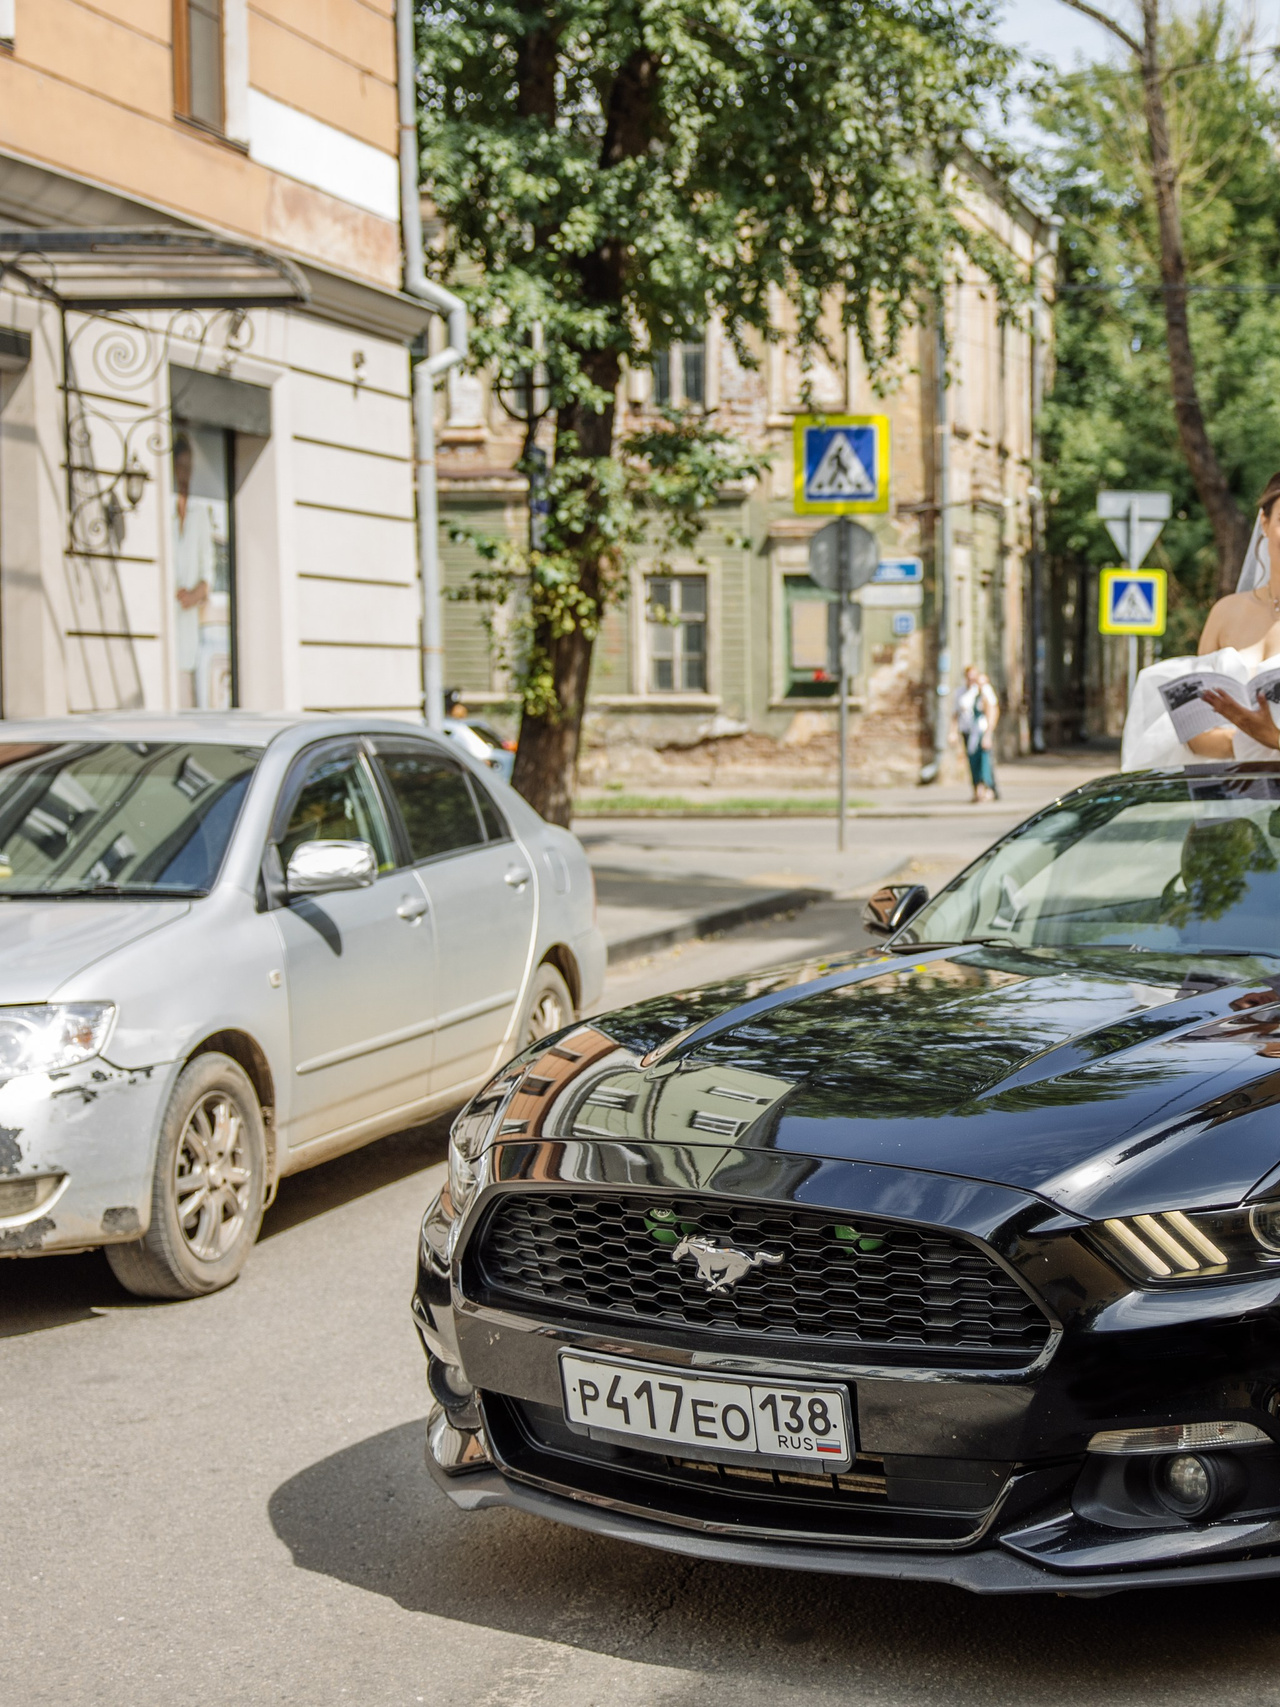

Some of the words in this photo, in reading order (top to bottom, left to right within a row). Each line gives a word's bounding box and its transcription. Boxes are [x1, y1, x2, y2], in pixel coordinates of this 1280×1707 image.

[578, 1374, 750, 1442] Р417ЕО
[758, 1393, 832, 1437] 138
[777, 1434, 814, 1451] RUS
